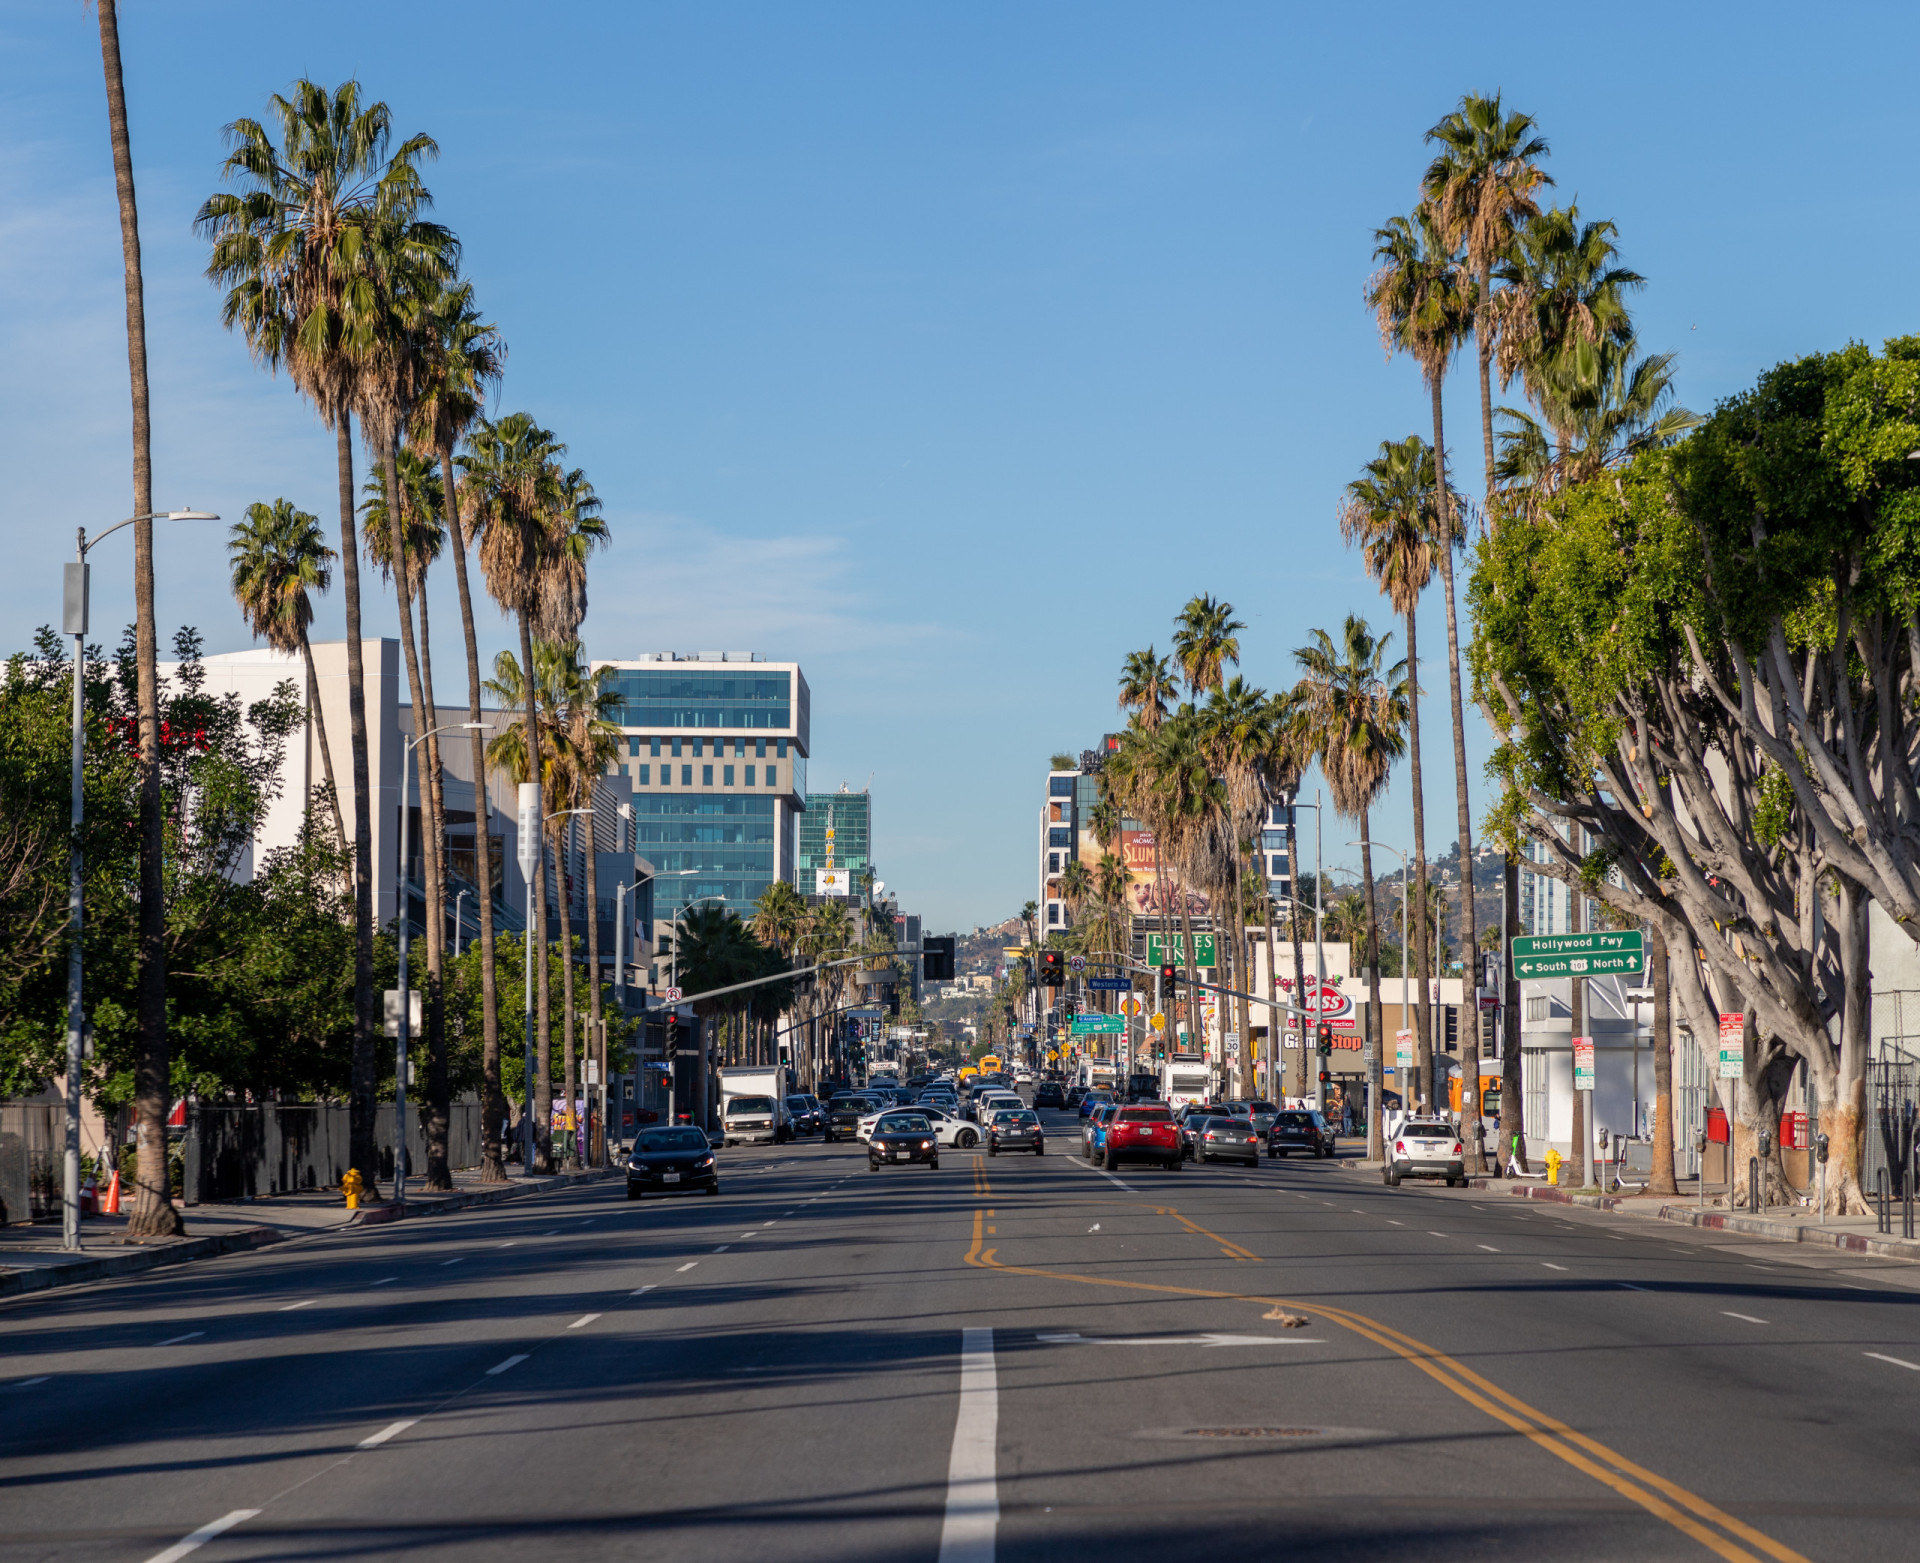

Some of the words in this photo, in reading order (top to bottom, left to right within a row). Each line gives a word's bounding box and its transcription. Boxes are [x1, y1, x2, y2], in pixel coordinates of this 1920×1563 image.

[1532, 938, 1592, 951] Hollywood
[1600, 936, 1624, 948] Fwy
[1535, 961, 1567, 972] South
[1573, 962, 1585, 970] 101
[1593, 958, 1624, 969] North
[1305, 995, 1340, 1009] WSS
[1284, 1033, 1362, 1051] GamStop
